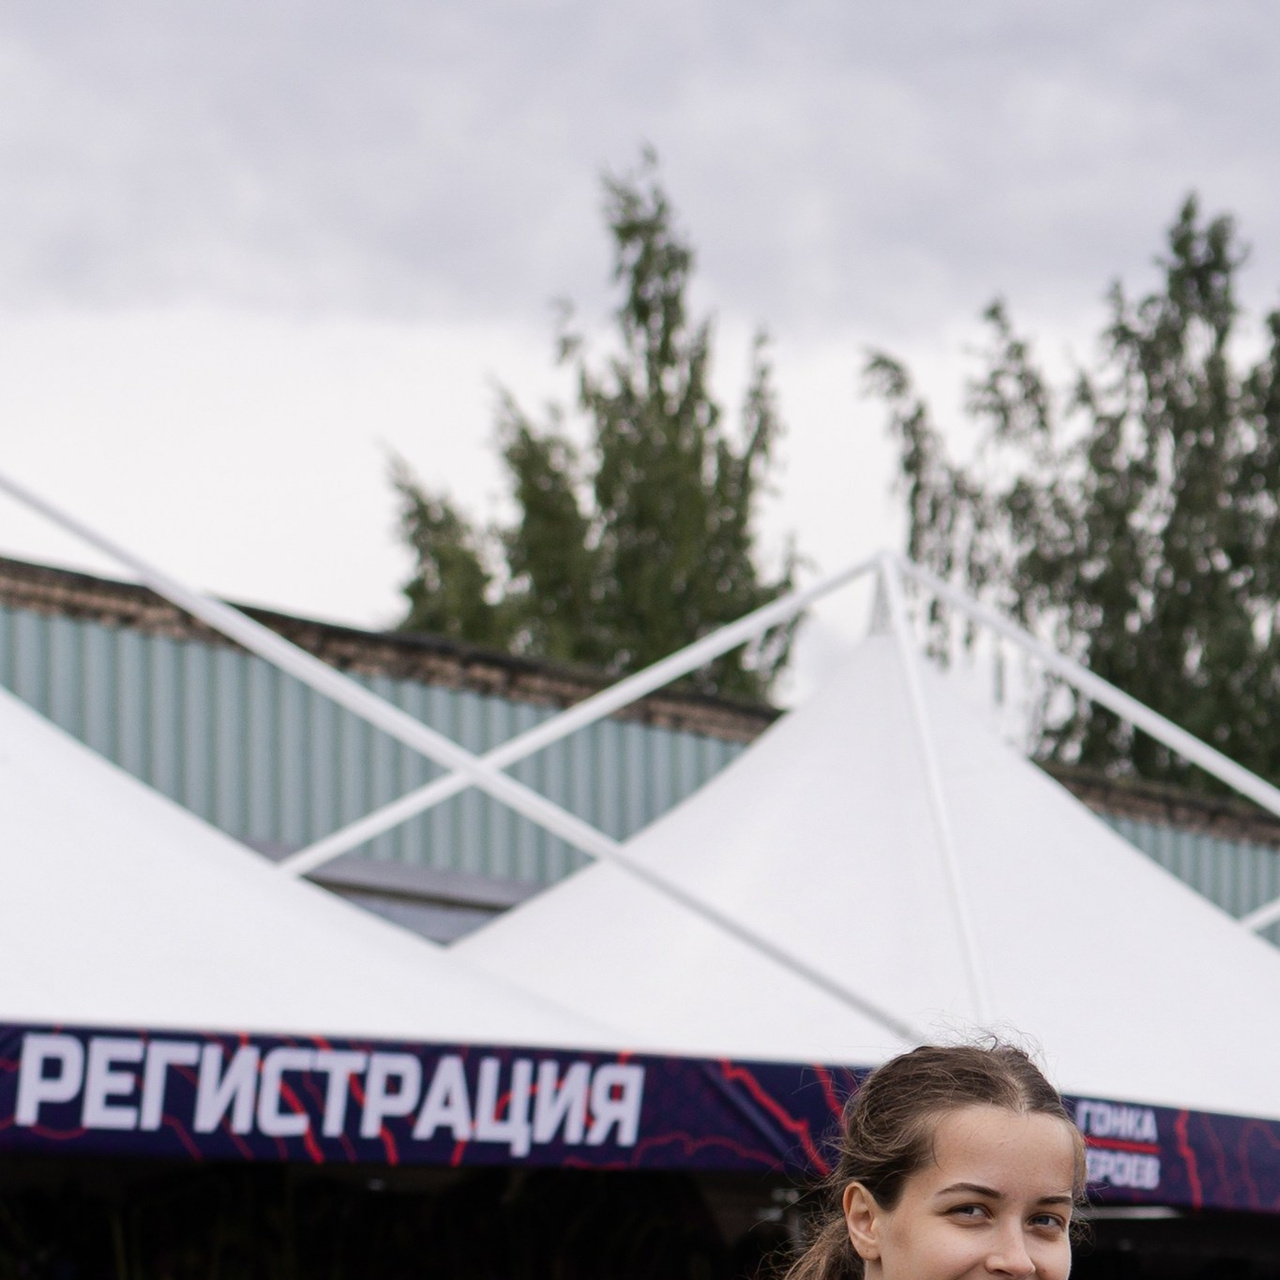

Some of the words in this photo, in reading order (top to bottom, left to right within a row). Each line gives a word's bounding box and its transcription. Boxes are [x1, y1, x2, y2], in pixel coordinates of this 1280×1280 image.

[15, 1033, 644, 1156] РЕГИСТРАЦИЯ
[1076, 1101, 1158, 1142] ГОНКА
[1085, 1149, 1160, 1189] ЕРОЕВ
